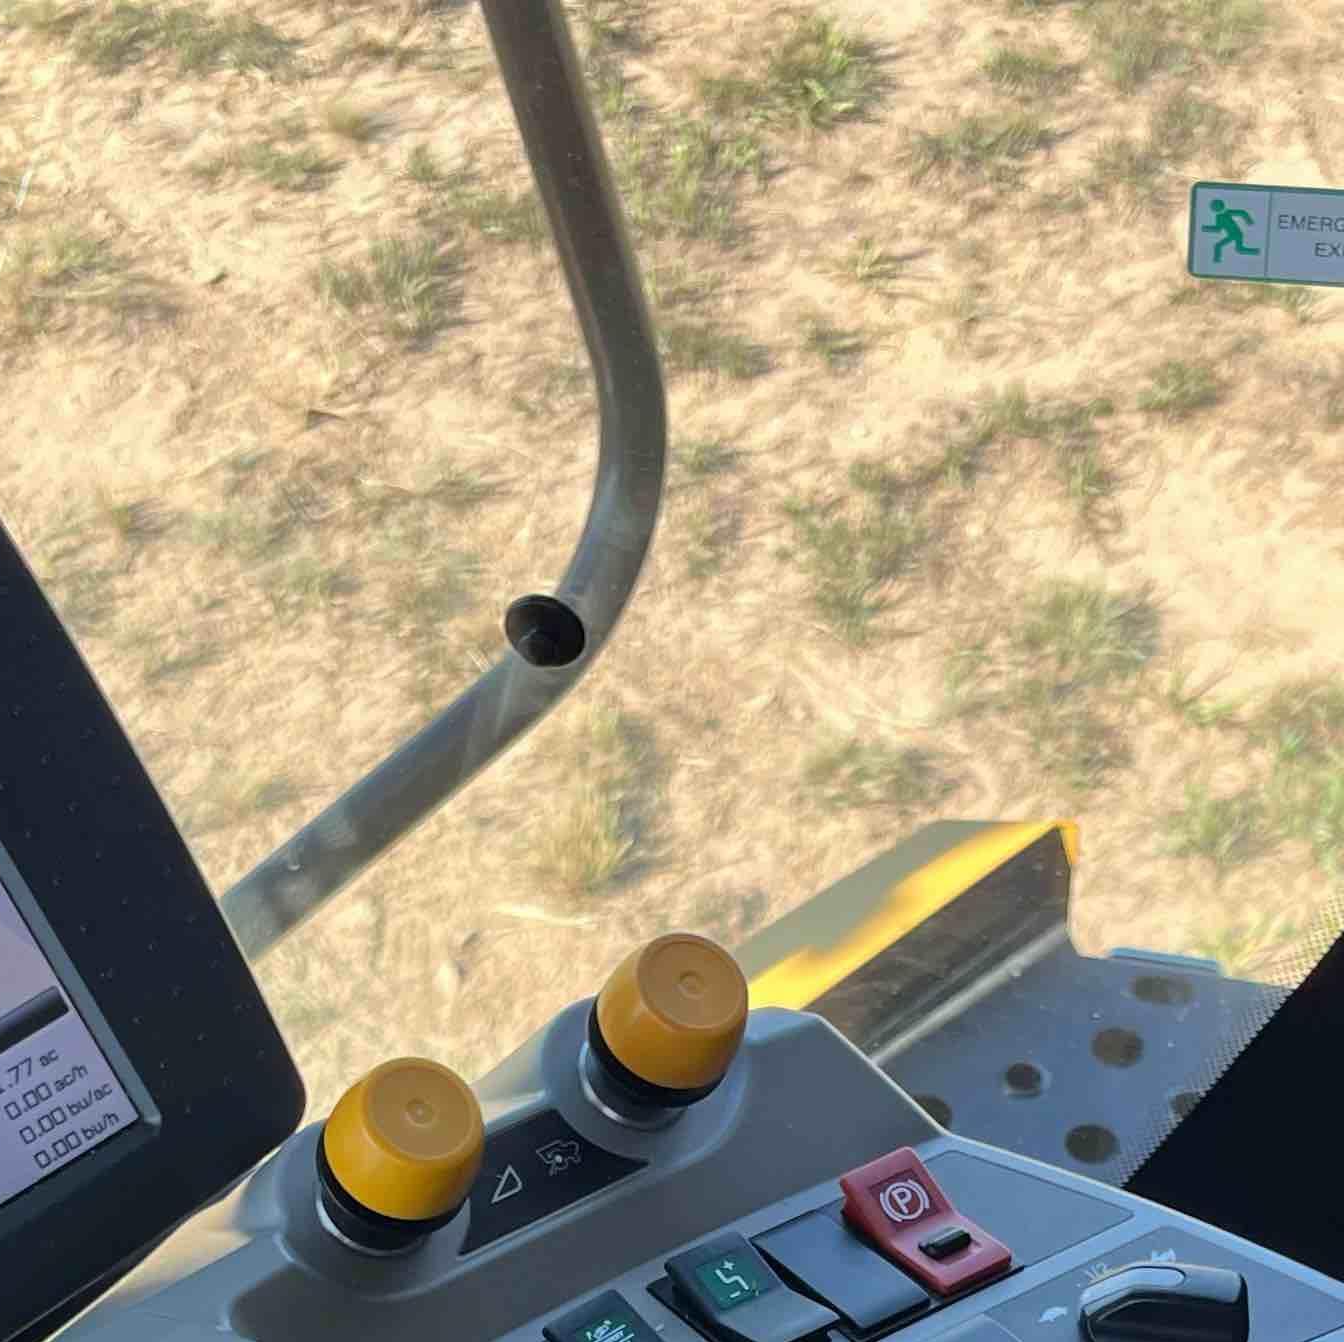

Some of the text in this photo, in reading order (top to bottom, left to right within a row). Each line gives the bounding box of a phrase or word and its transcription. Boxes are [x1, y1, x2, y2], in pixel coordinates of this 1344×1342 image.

[39, 1049, 59, 1067] ac
[4, 1064, 89, 1120] 0.00 ac/h
[19, 1083, 113, 1145] 0.00 bu/ac
[33, 1111, 120, 1169] 0.00 bu/h
